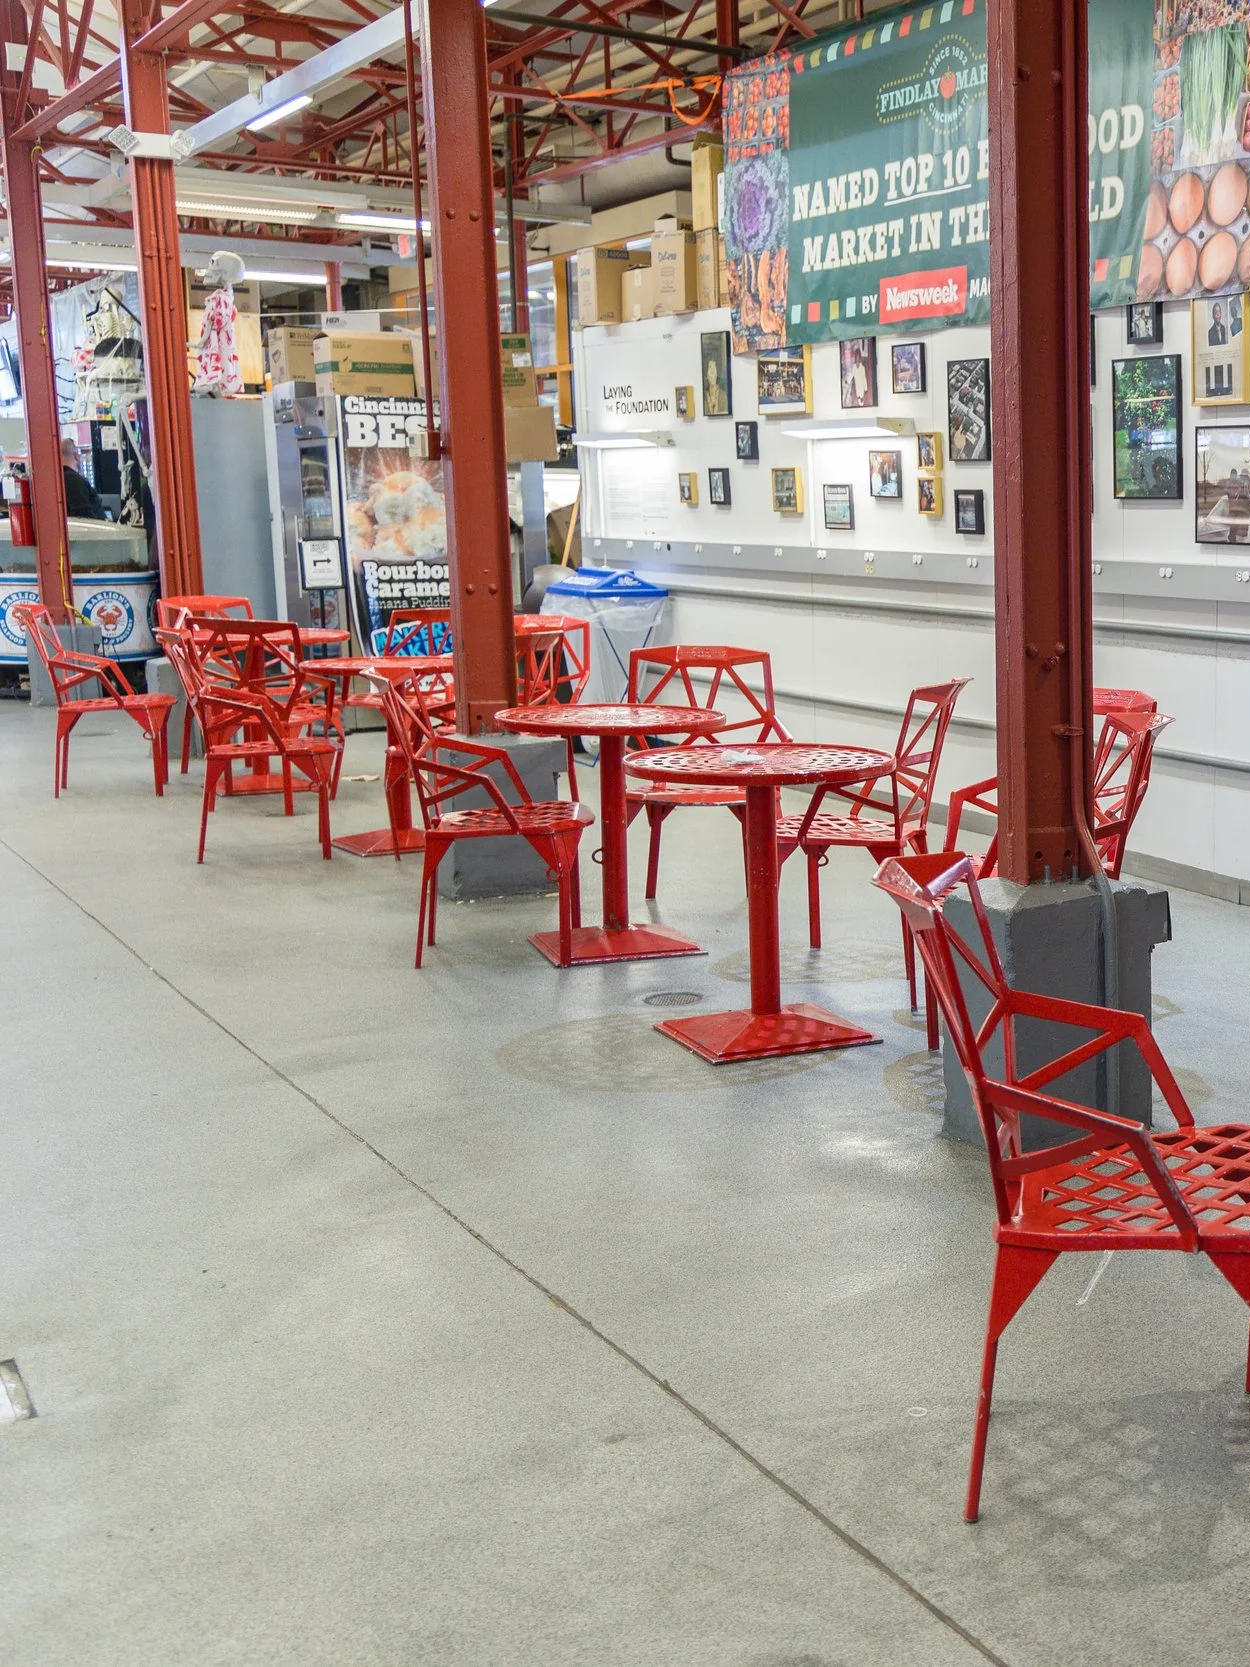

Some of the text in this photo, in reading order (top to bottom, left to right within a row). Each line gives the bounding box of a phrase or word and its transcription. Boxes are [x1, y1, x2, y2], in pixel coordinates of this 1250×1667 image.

[930, 46, 968, 76] SINCE 1852
[880, 63, 988, 113] FINDLAY MAR
[929, 93, 968, 124] CINCINNATI
[792, 168, 879, 222] NAMED
[884, 153, 934, 200] TOP
[942, 145, 970, 188] 10
[802, 200, 990, 273] MARKET IN TH
[862, 294, 878, 315] BY
[885, 278, 958, 312] Newsweek
[603, 385, 632, 400] LAYING
[615, 399, 669, 415] FOUNDATION
[1, 591, 39, 610] BARLIO
[85, 591, 130, 610] BARLION'S
[365, 579, 450, 598] Carame
[411, 597, 450, 609] Puddin
